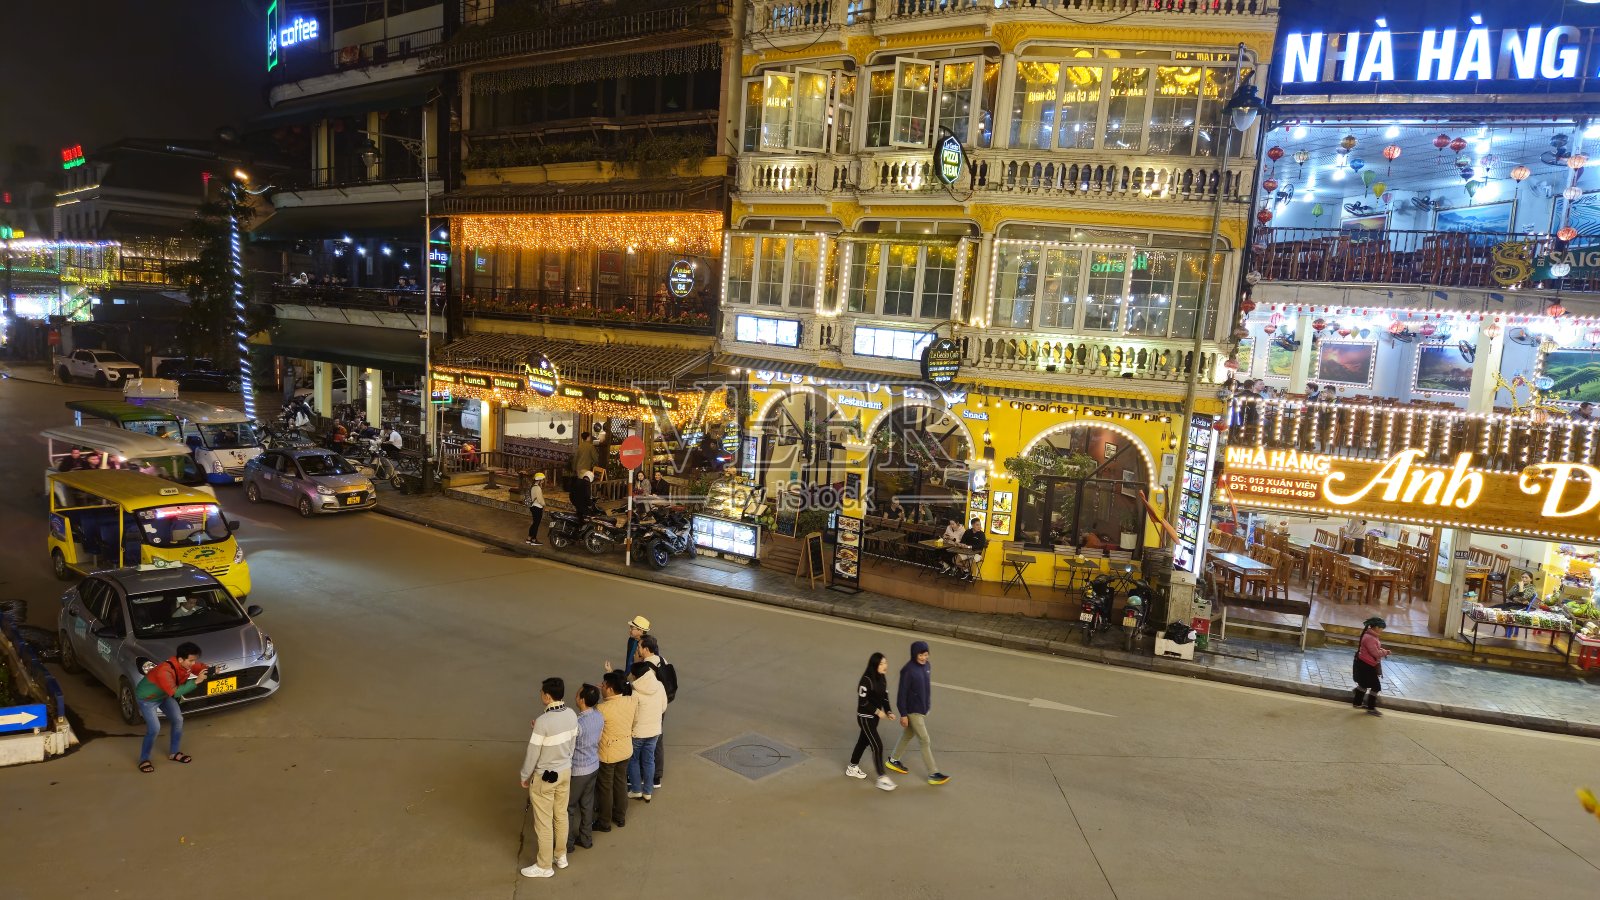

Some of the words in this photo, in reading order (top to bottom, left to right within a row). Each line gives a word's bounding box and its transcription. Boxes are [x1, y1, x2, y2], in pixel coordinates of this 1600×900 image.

[281, 18, 317, 47] coffee
[1282, 18, 1394, 83] NHÀ
[1416, 15, 1581, 81] HÀNG
[944, 150, 958, 164] PIZZA
[944, 163, 958, 177] STEAK
[430, 249, 447, 260] aha
[525, 363, 554, 378] Anise
[463, 376, 486, 386] Lunch
[494, 378, 518, 388] Dinner
[565, 387, 583, 397] Bistro
[598, 391, 610, 400] Egg
[610, 393, 630, 402] Coffee
[639, 397, 660, 407] Herbal
[661, 399, 672, 408] Tea
[838, 394, 883, 410] Restaurant
[930, 412, 950, 426] Le
[962, 410, 989, 420] Snack
[1227, 446, 1267, 466] NHÀ
[1271, 449, 1330, 472] HÀNG
[1230, 475, 1247, 483] ĐC:
[1249, 476, 1265, 485] 012
[1267, 478, 1293, 488] XUÂN
[1323, 448, 1484, 509] Anh
[1230, 483, 1248, 491] ĐT:
[1251, 485, 1316, 498] 0919601499
[858, 685, 868, 698] C
